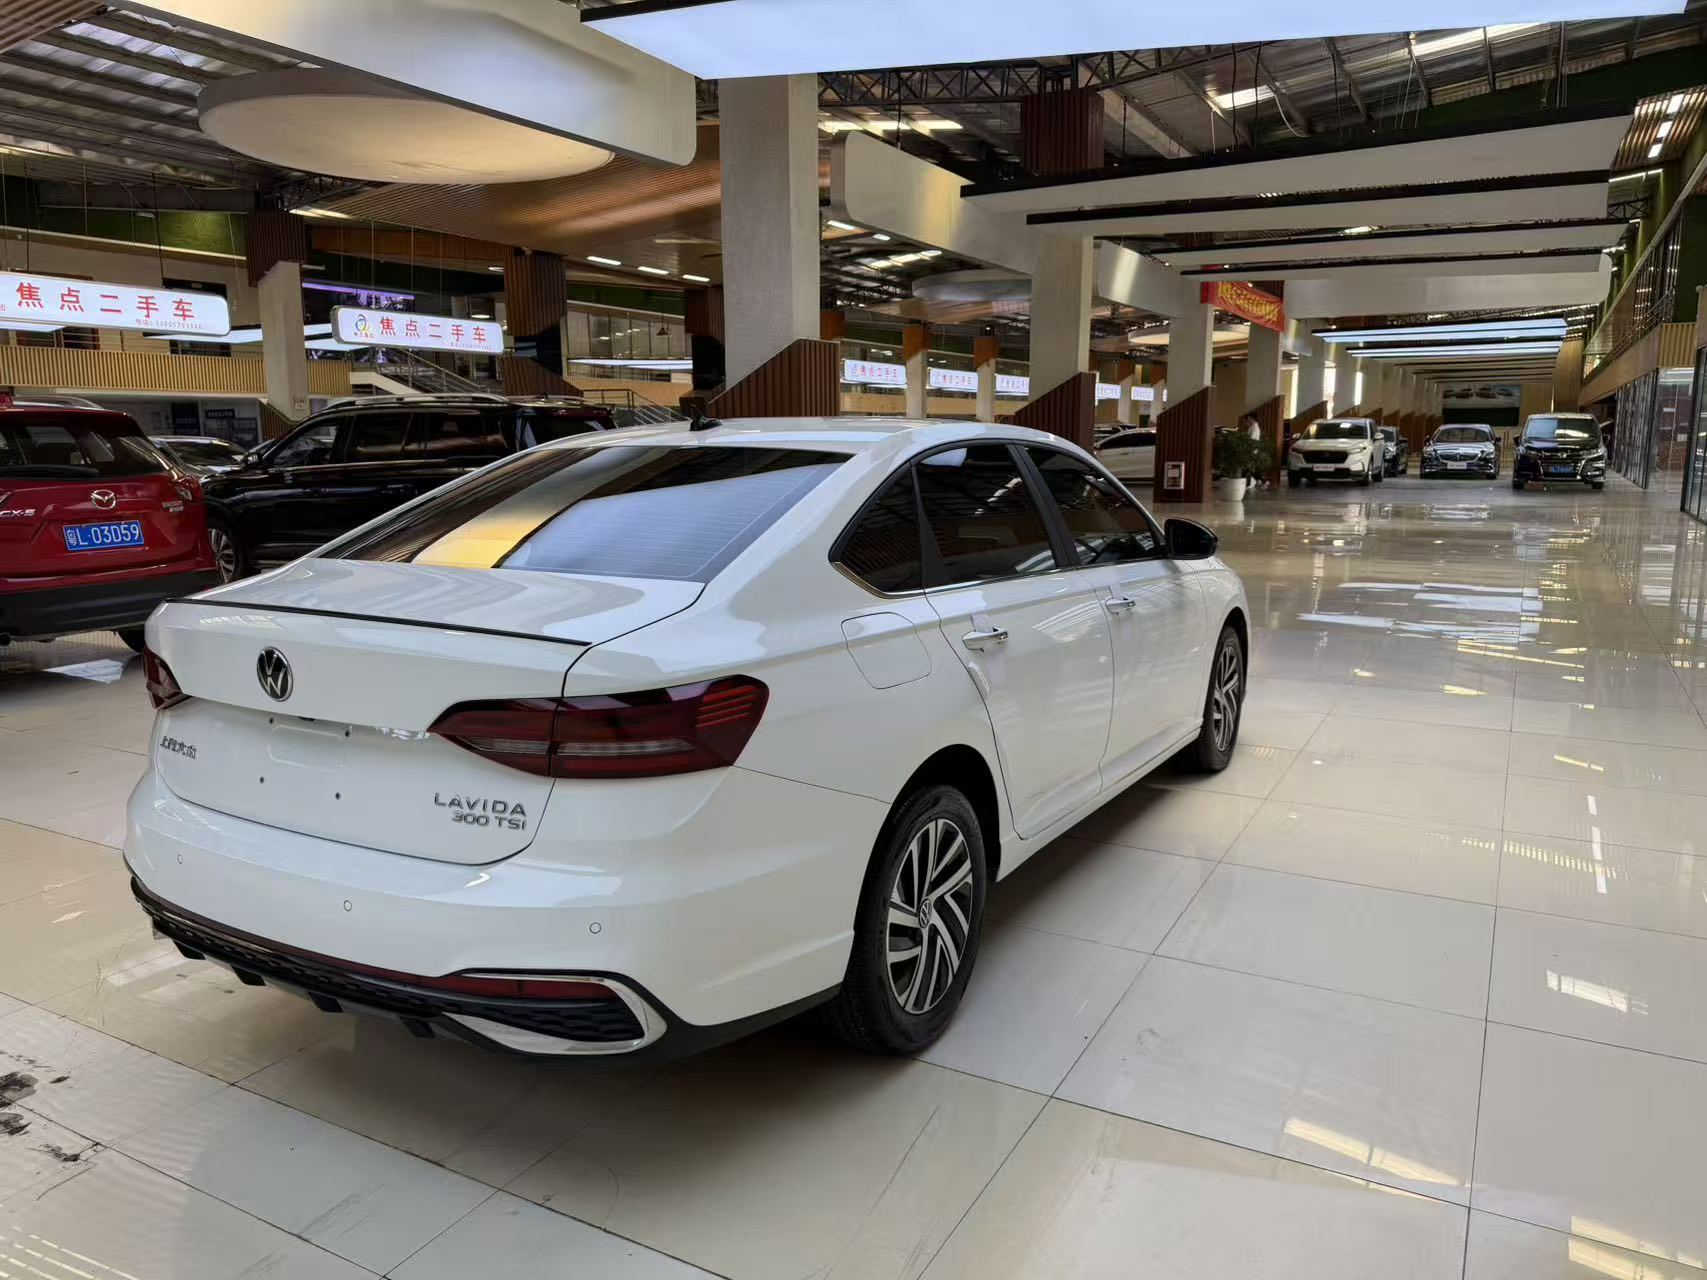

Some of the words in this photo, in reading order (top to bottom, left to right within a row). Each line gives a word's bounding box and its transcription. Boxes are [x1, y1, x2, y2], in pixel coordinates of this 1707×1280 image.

[16, 281, 195, 320] 焦点二手车
[380, 316, 487, 343] 焦点二手车
[434, 792, 527, 817] LAVIDA
[452, 810, 490, 826] 300
[495, 815, 527, 831] TSI
